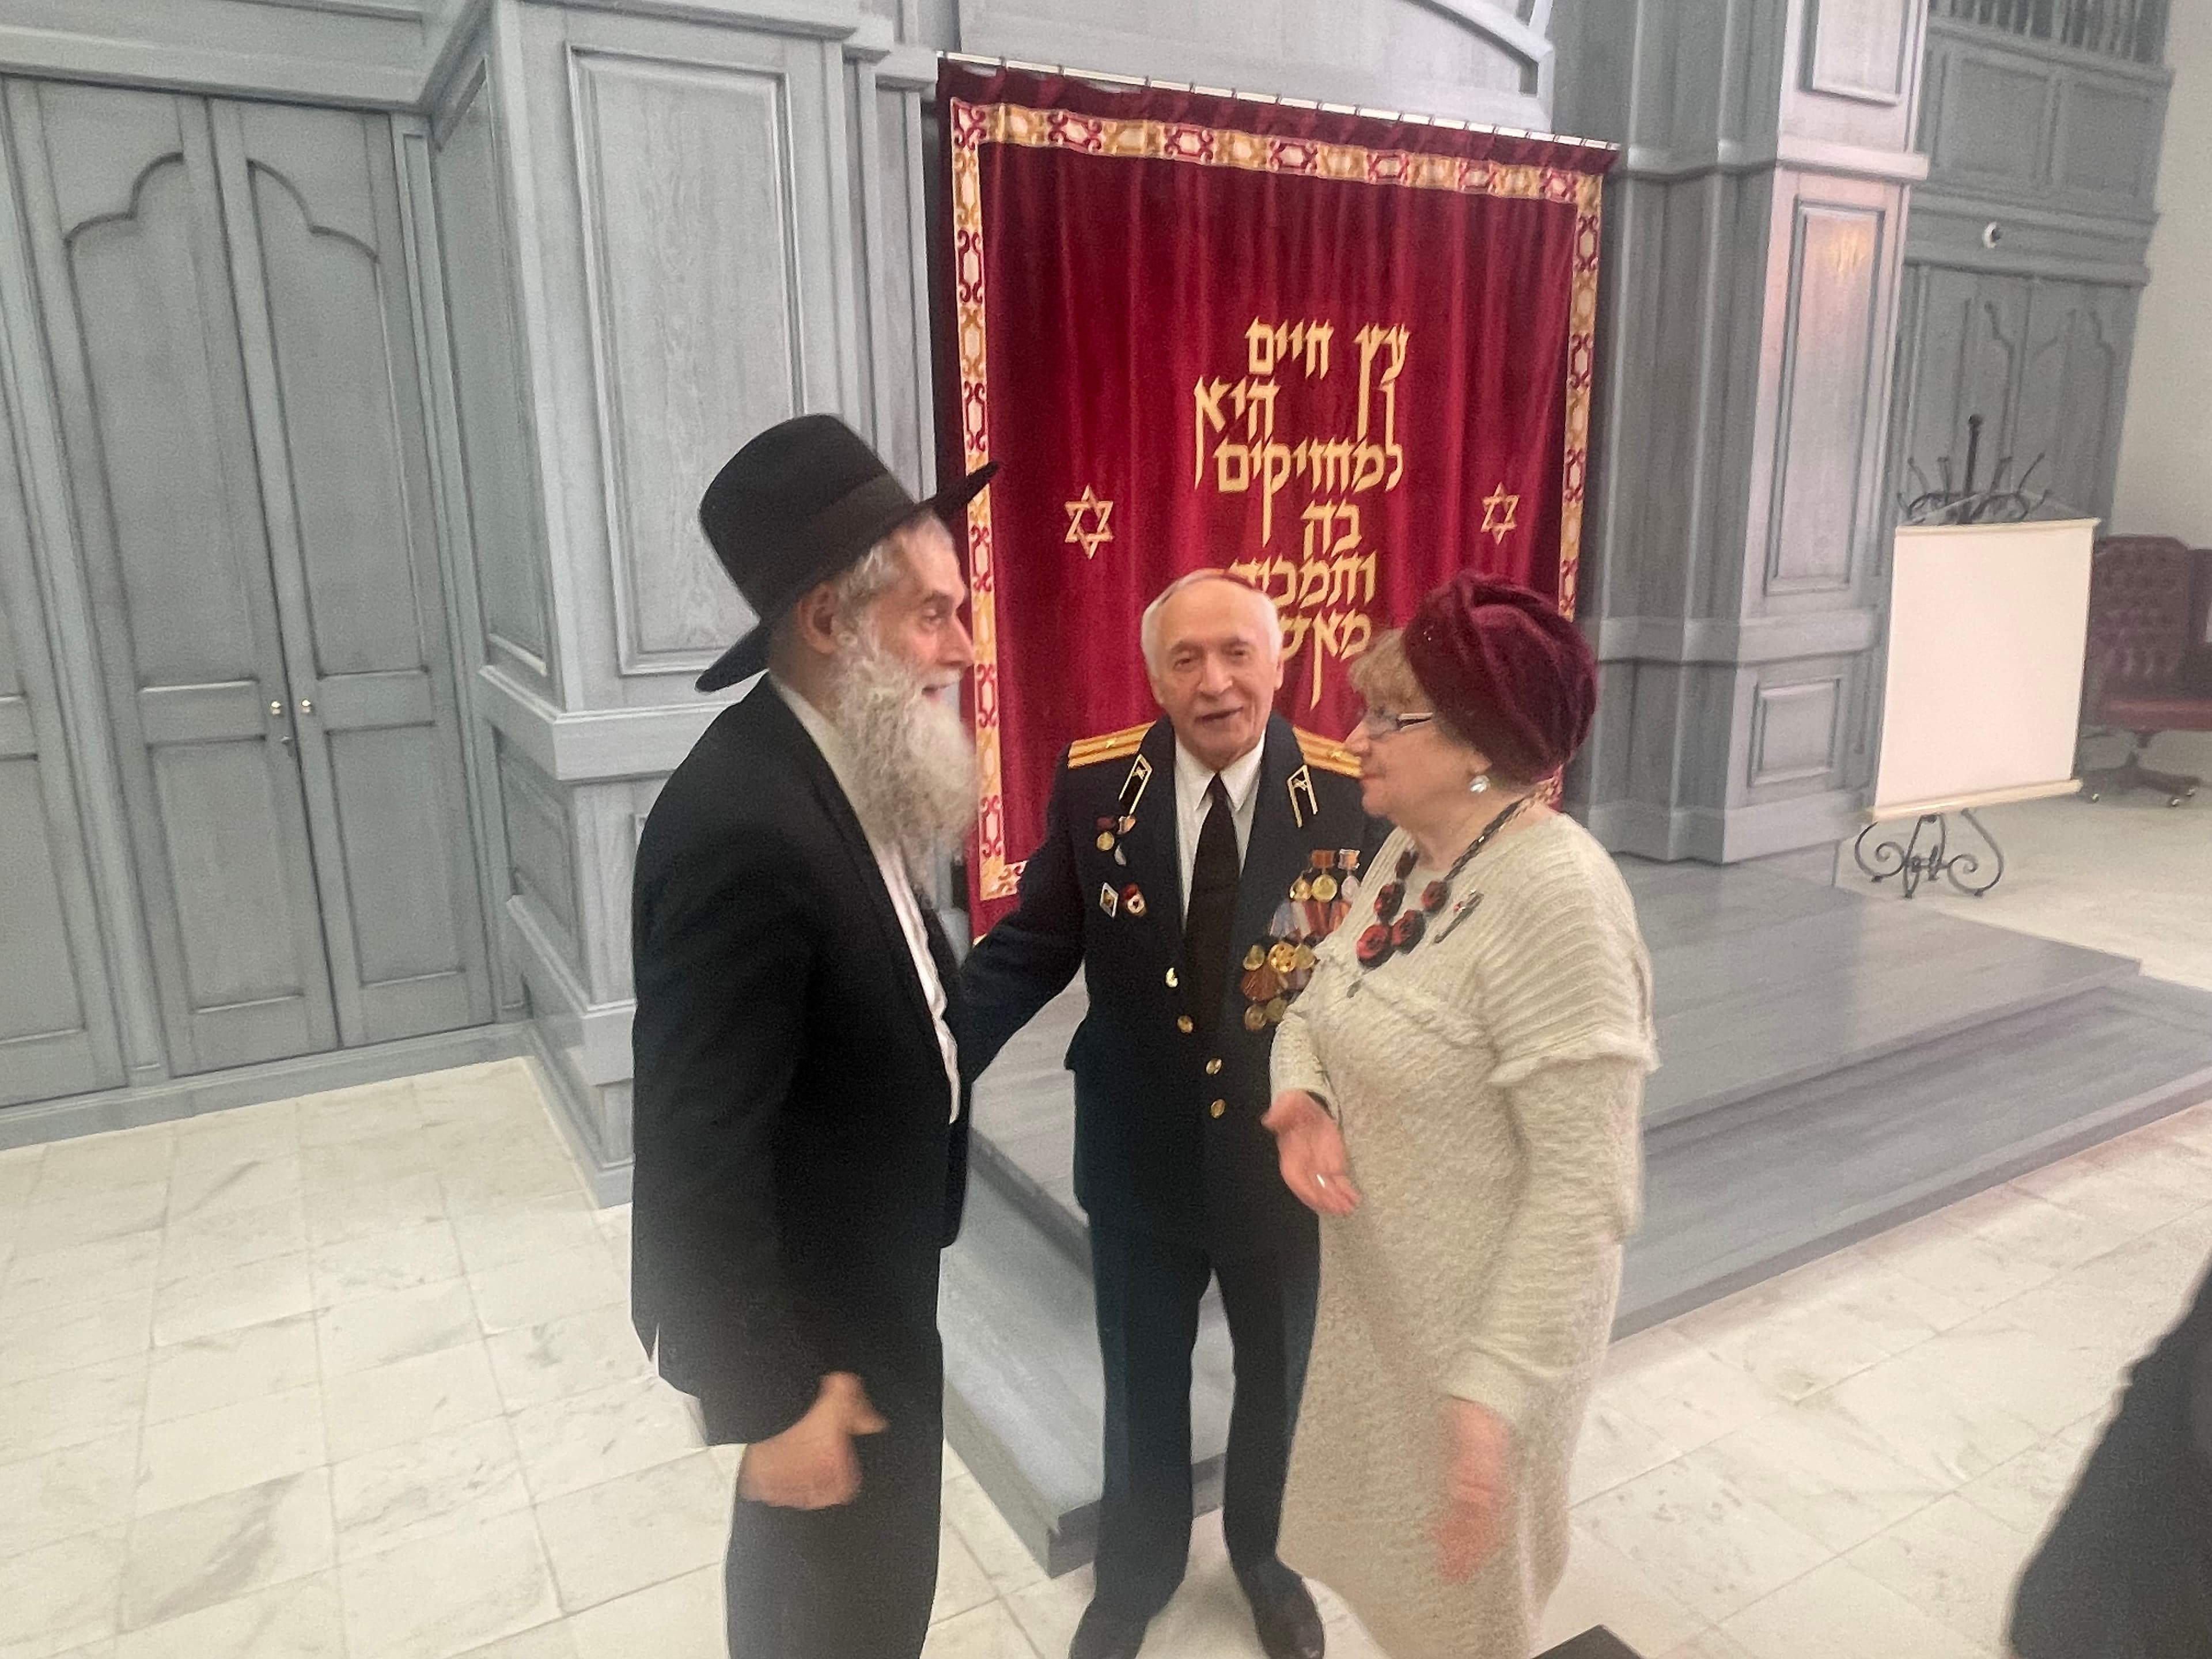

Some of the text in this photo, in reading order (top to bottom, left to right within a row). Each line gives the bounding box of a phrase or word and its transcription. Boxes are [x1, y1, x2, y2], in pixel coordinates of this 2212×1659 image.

[1194, 375, 1281, 490] היא
[1245, 316, 1410, 442] עץ חיים
[1213, 381, 1403, 547] למחזיקים
[1301, 499, 1363, 562] בה
[1279, 608, 1372, 712] מאש
